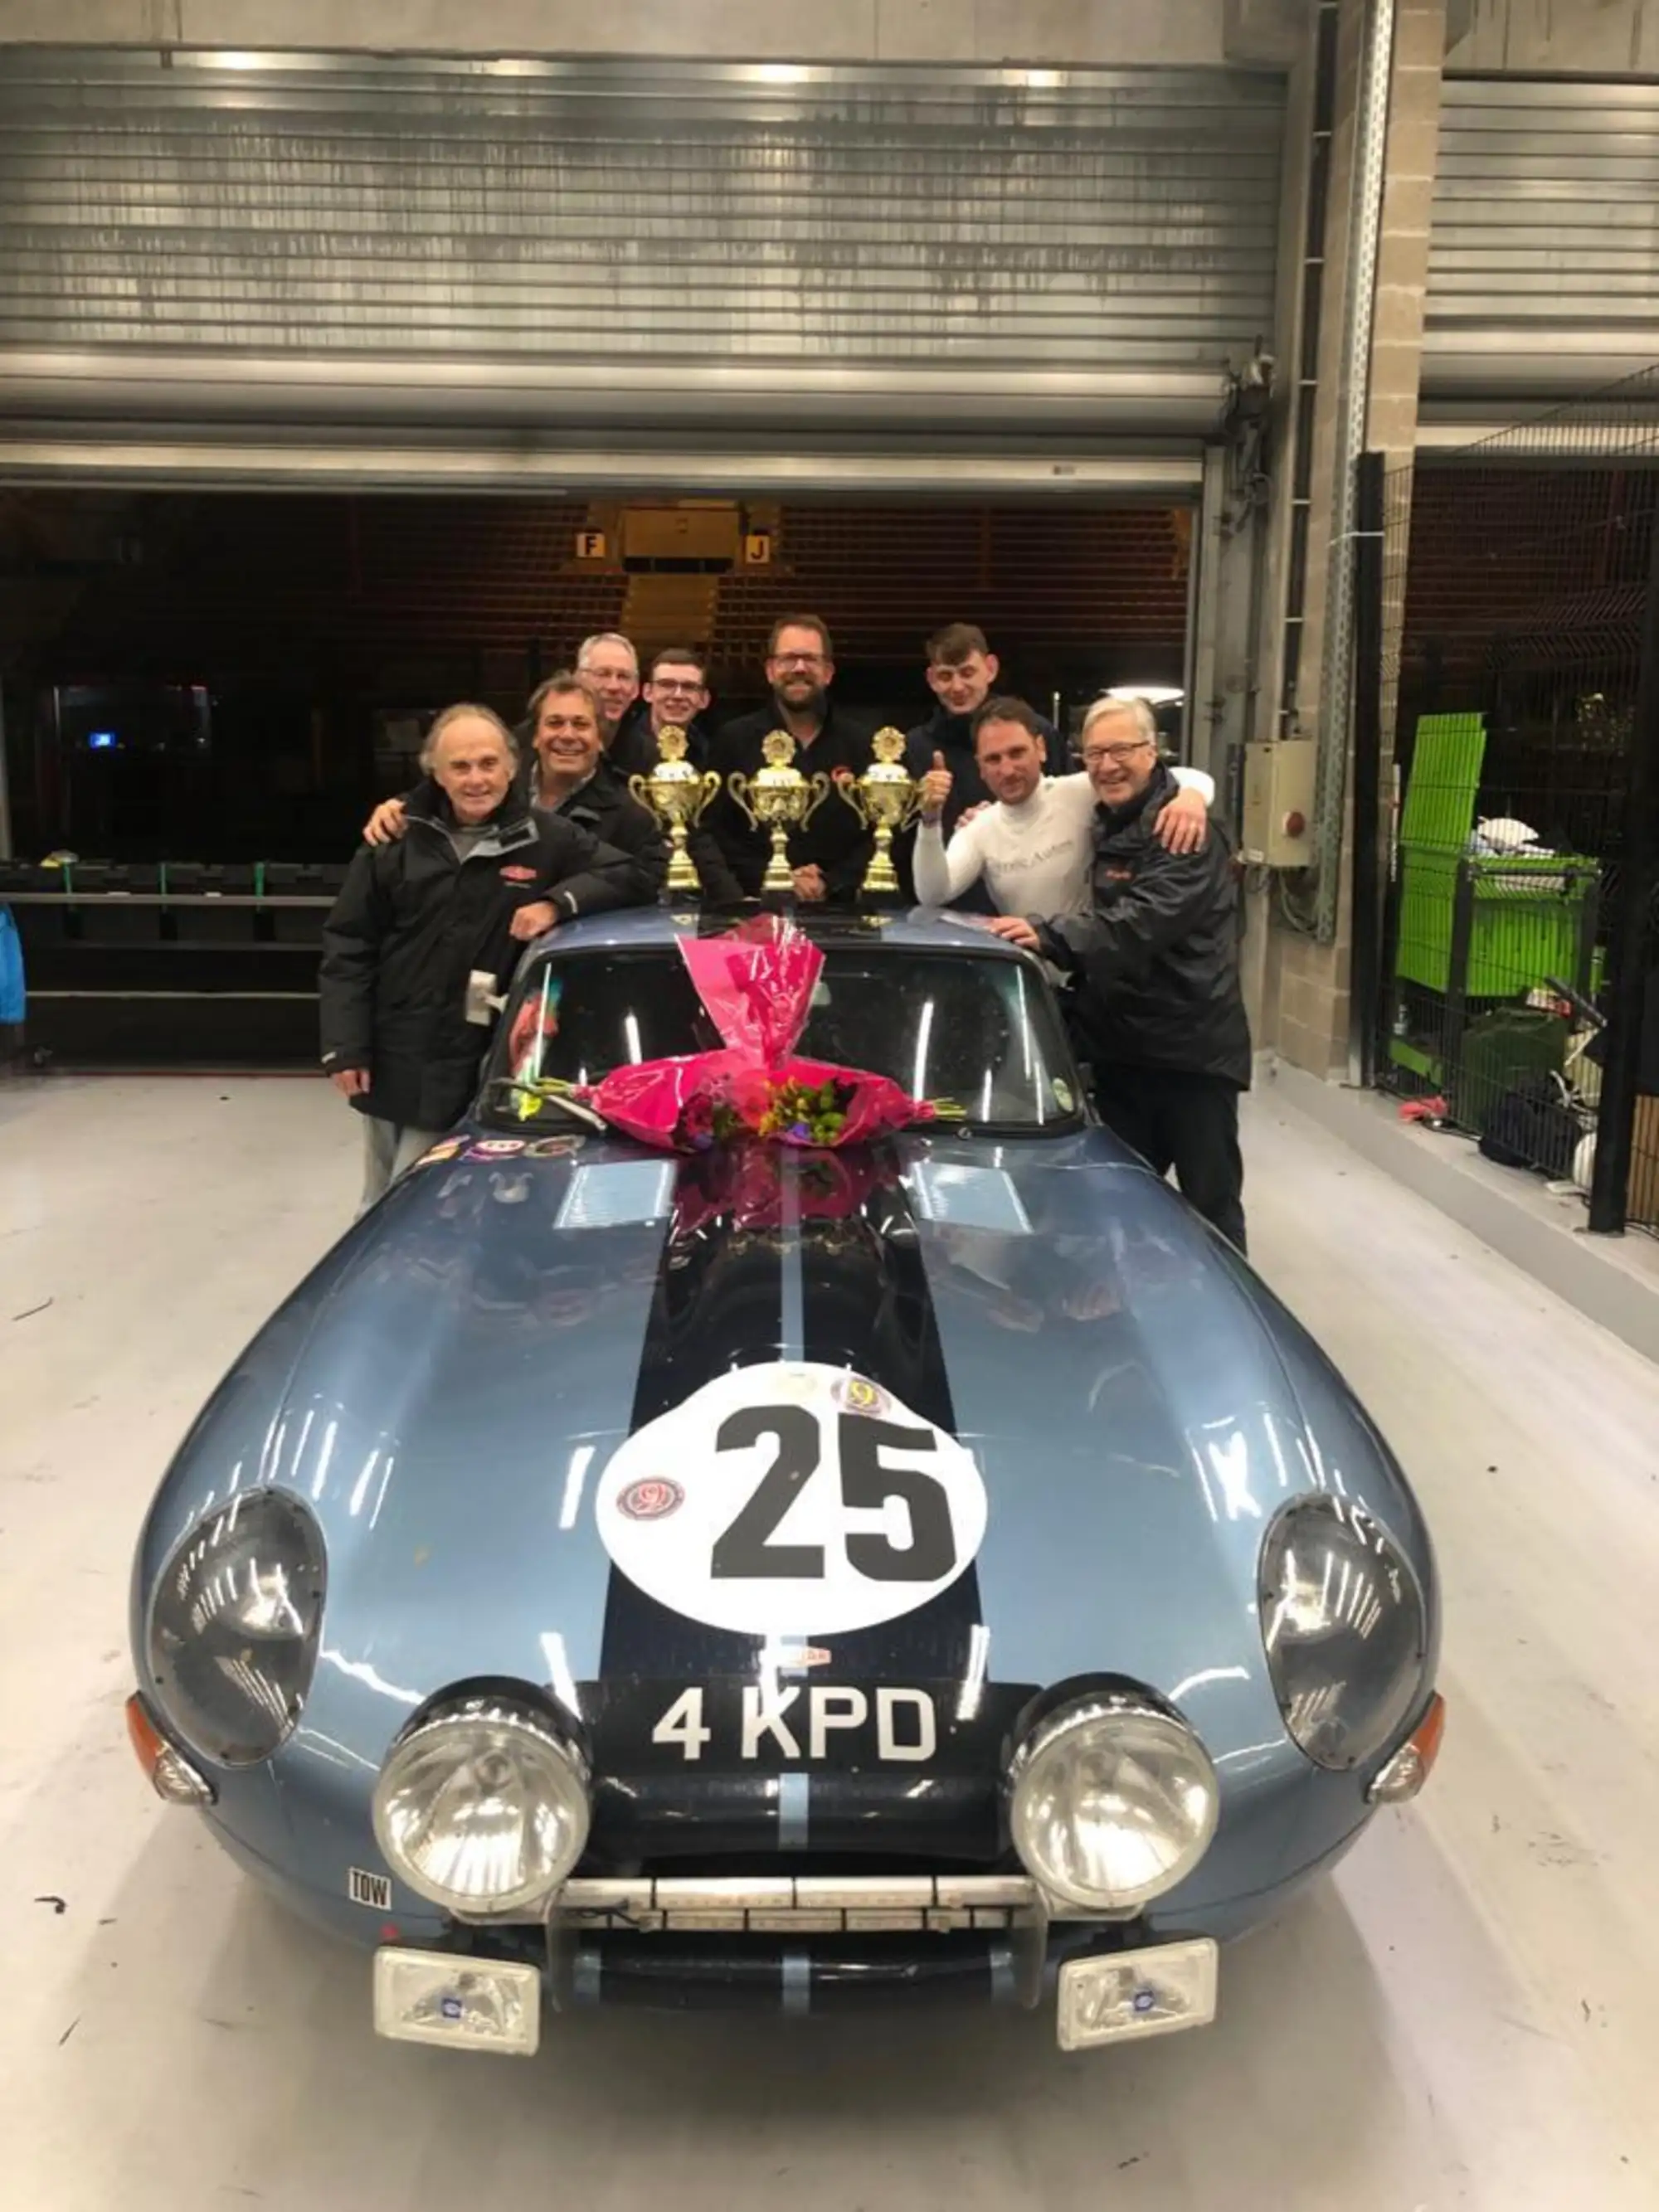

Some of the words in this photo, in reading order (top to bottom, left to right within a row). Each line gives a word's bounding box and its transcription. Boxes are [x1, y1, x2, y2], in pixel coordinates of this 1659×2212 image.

[584, 535, 596, 556] F
[751, 540, 765, 559] J
[711, 1405, 956, 1582] 25
[652, 1687, 711, 1760] 4
[742, 1686, 937, 1762] KPD
[353, 1871, 387, 1906] TOW
